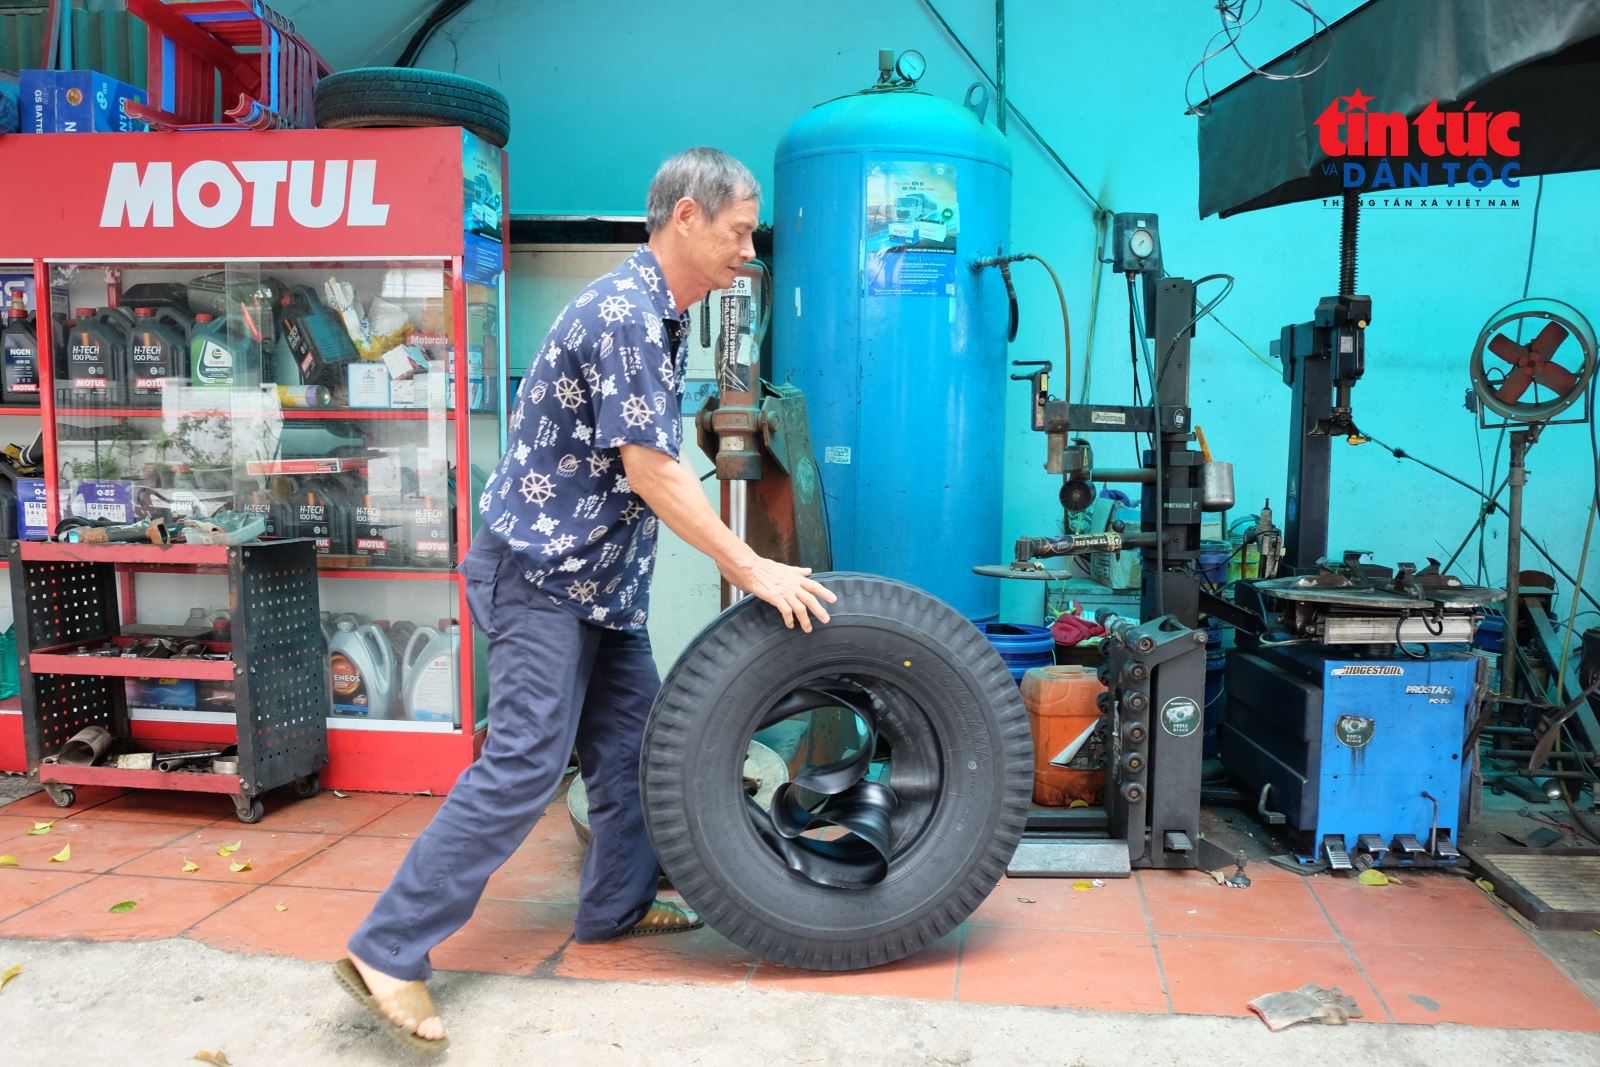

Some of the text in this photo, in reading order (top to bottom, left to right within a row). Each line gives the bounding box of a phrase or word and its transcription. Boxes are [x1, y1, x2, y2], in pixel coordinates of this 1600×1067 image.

[34, 89, 42, 103] GS
[99, 159, 391, 229] MOTUL
[729, 297, 736, 307] XL
[10, 348, 31, 356] NGEN
[72, 345, 100, 354] H-TECH
[133, 345, 161, 354] H-TECH
[75, 379, 105, 387] MOTUL
[137, 379, 168, 388] MOTUL
[244, 504, 271, 513] H-TECH
[300, 505, 324, 514] H-TECH
[356, 507, 381, 516] H-TECH
[415, 509, 443, 518] H-TECH
[359, 541, 386, 549] MOTUL
[333, 674, 361, 683] ENEOS
